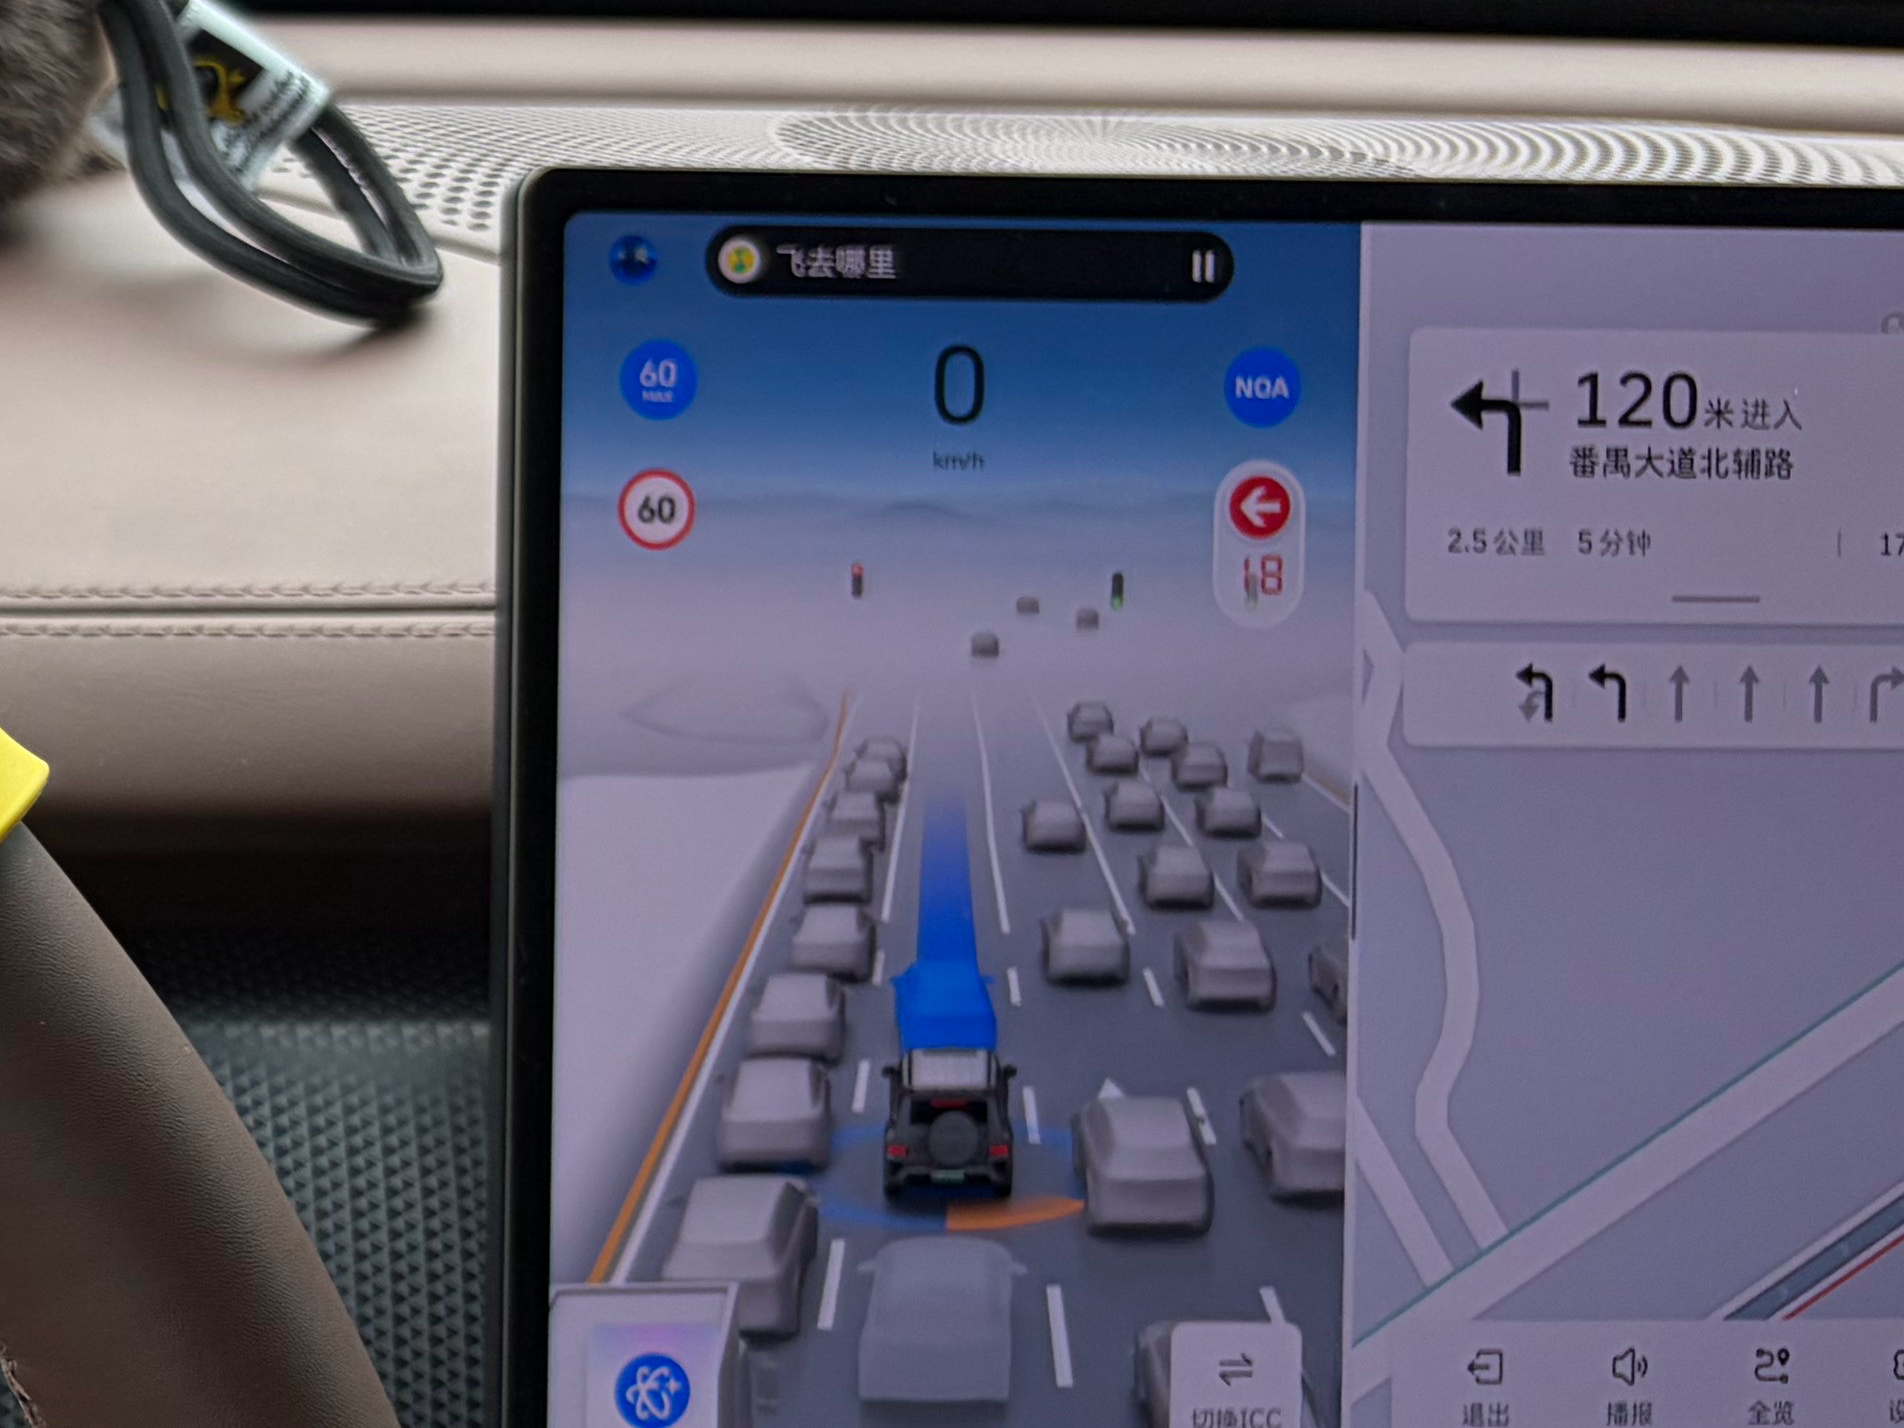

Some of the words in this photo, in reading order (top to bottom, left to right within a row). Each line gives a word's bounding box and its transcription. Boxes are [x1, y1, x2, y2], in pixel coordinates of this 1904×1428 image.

[639, 358, 678, 388] 60
[933, 344, 985, 425] 0
[1236, 375, 1290, 400] NOA
[932, 450, 986, 472] km/h
[1569, 445, 1794, 482] 番禺大道北辅路
[637, 495, 676, 525] 60
[1605, 1401, 1654, 1428] 播报
[1747, 1399, 1795, 1427] 全览
